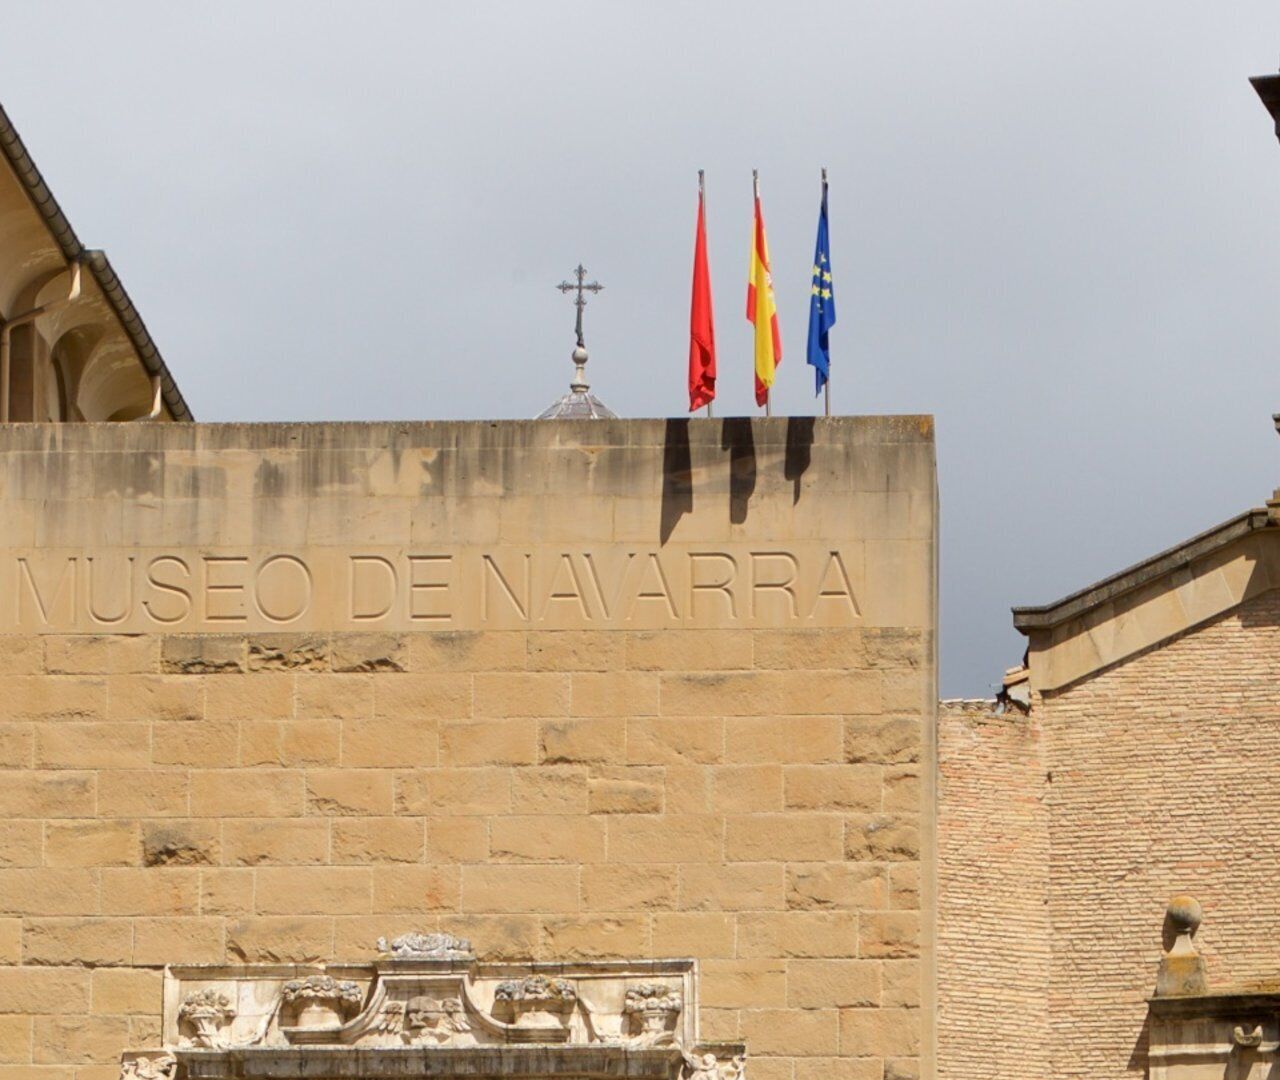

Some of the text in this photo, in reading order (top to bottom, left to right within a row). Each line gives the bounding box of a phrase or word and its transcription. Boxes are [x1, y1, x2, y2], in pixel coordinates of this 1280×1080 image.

[17, 550, 863, 625] MUSEO DE NAVARRA
